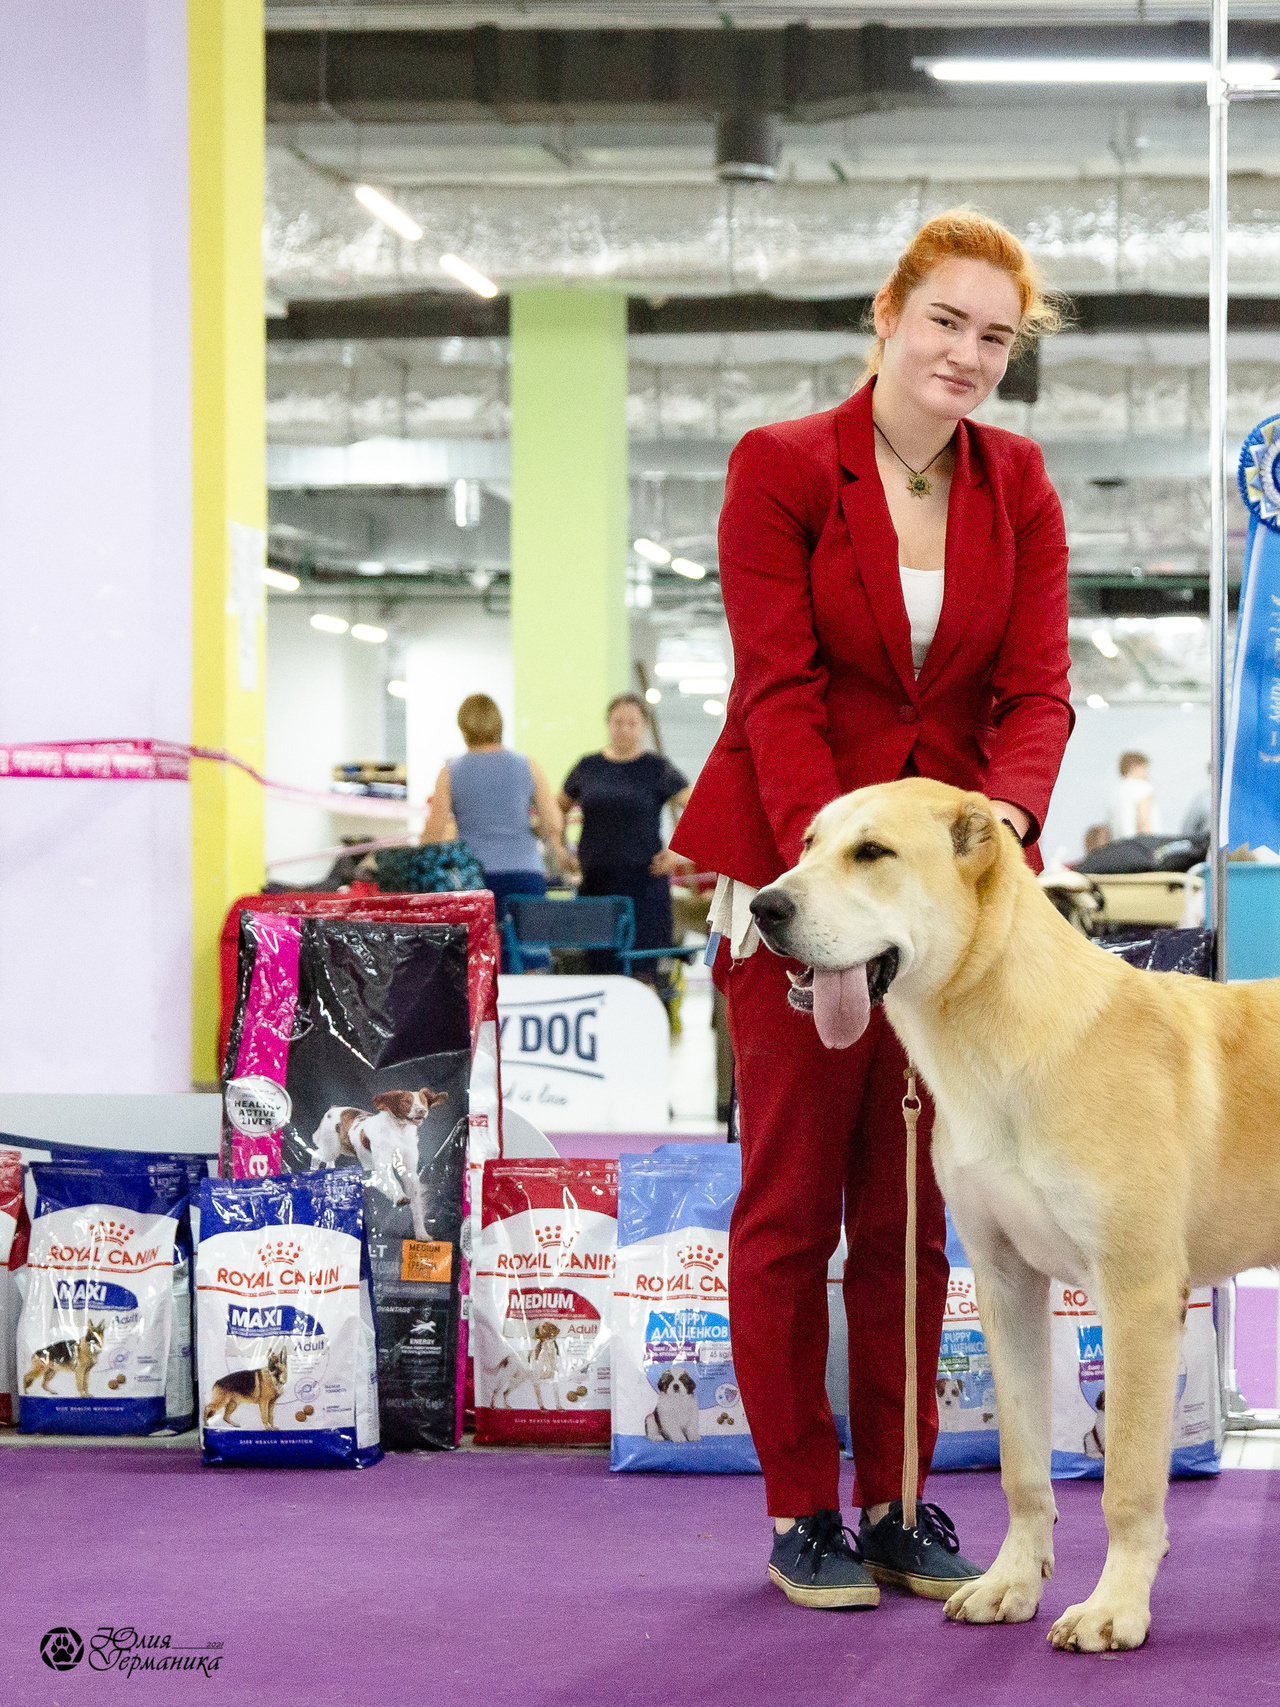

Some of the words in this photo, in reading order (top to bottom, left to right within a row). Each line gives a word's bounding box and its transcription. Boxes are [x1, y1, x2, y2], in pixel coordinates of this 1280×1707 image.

[519, 1006, 598, 1063] DOG
[238, 1108, 276, 1118] ACTIVE
[48, 1245, 101, 1263] ROYAL
[108, 1244, 161, 1267] CANIN
[497, 1252, 552, 1270] ROYAL
[217, 1267, 274, 1289] ROYAL
[279, 1265, 340, 1286] CANIN
[636, 1273, 695, 1293] ROYAL
[58, 1281, 107, 1302] MAXI
[510, 1293, 574, 1310] MEDIUM
[231, 1308, 283, 1329] MAXI
[674, 1311, 709, 1326] PUPPY
[567, 1324, 599, 1335] Adult
[944, 1331, 972, 1343] PUPPY
[293, 1340, 325, 1352] Adult
